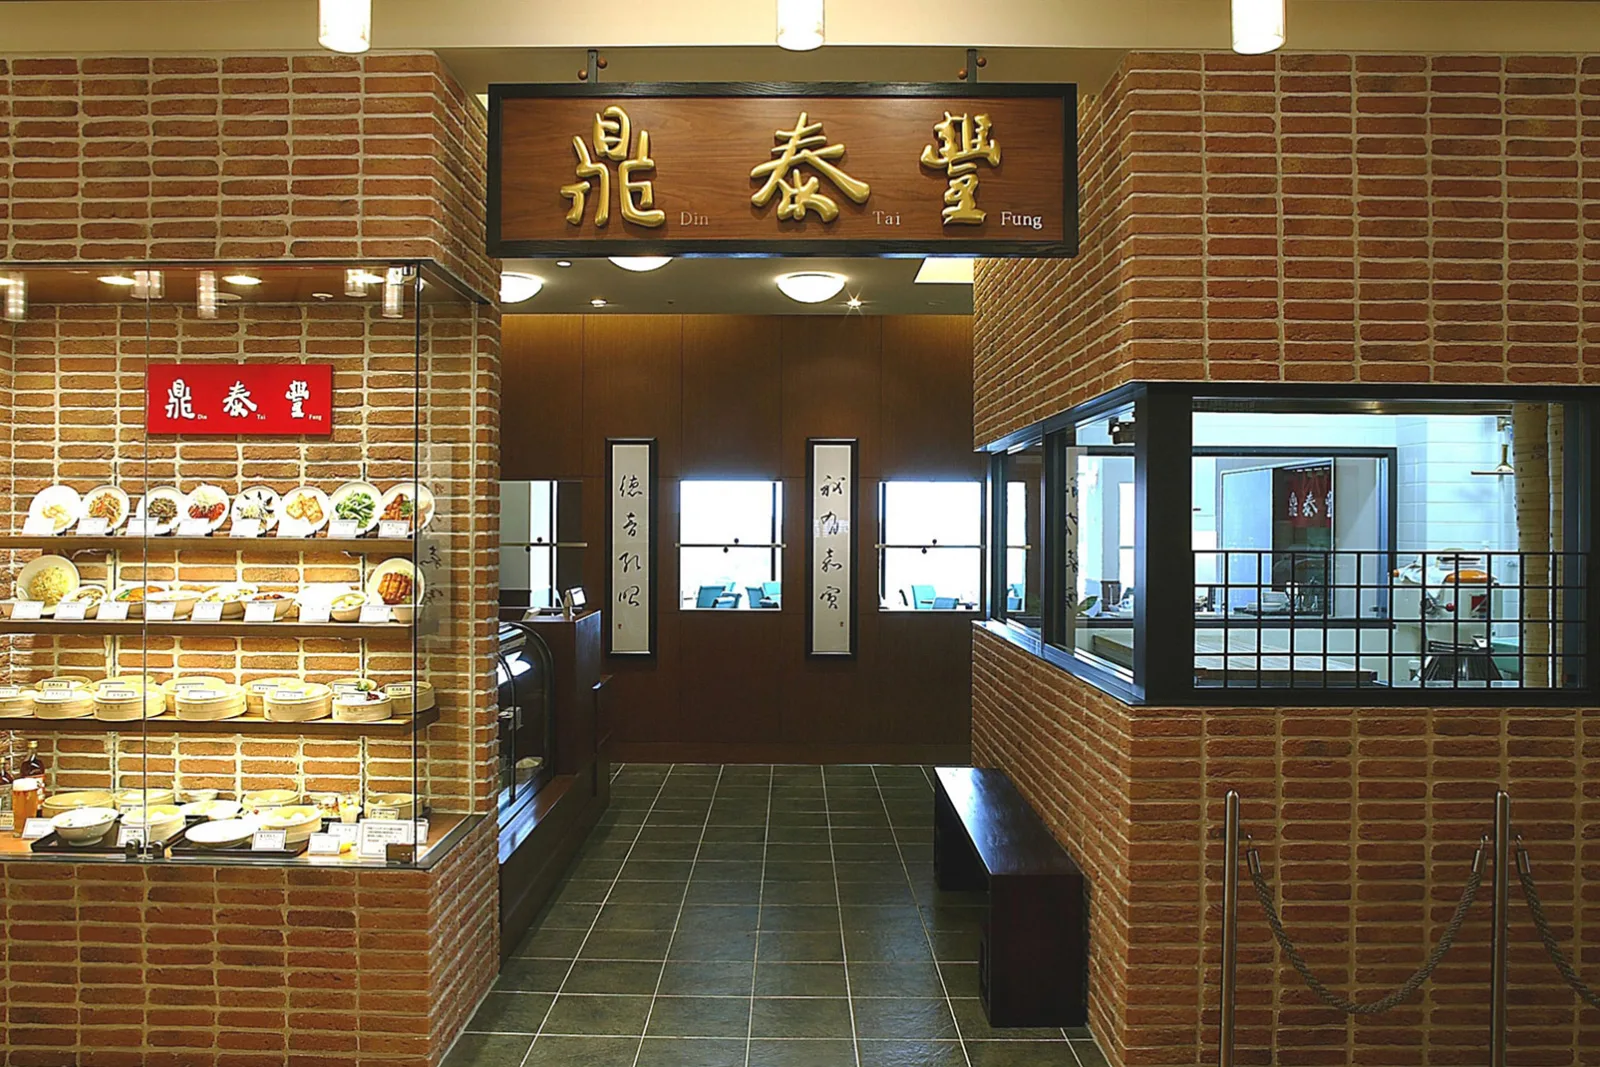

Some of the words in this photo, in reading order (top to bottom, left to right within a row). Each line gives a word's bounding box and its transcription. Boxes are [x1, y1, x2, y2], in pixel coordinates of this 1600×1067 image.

[560, 105, 1002, 227] 鼎泰豐
[680, 211, 709, 226] Din
[873, 211, 901, 226] Tai
[1000, 211, 1043, 229] Fung
[165, 379, 309, 418] 鼎泰豐
